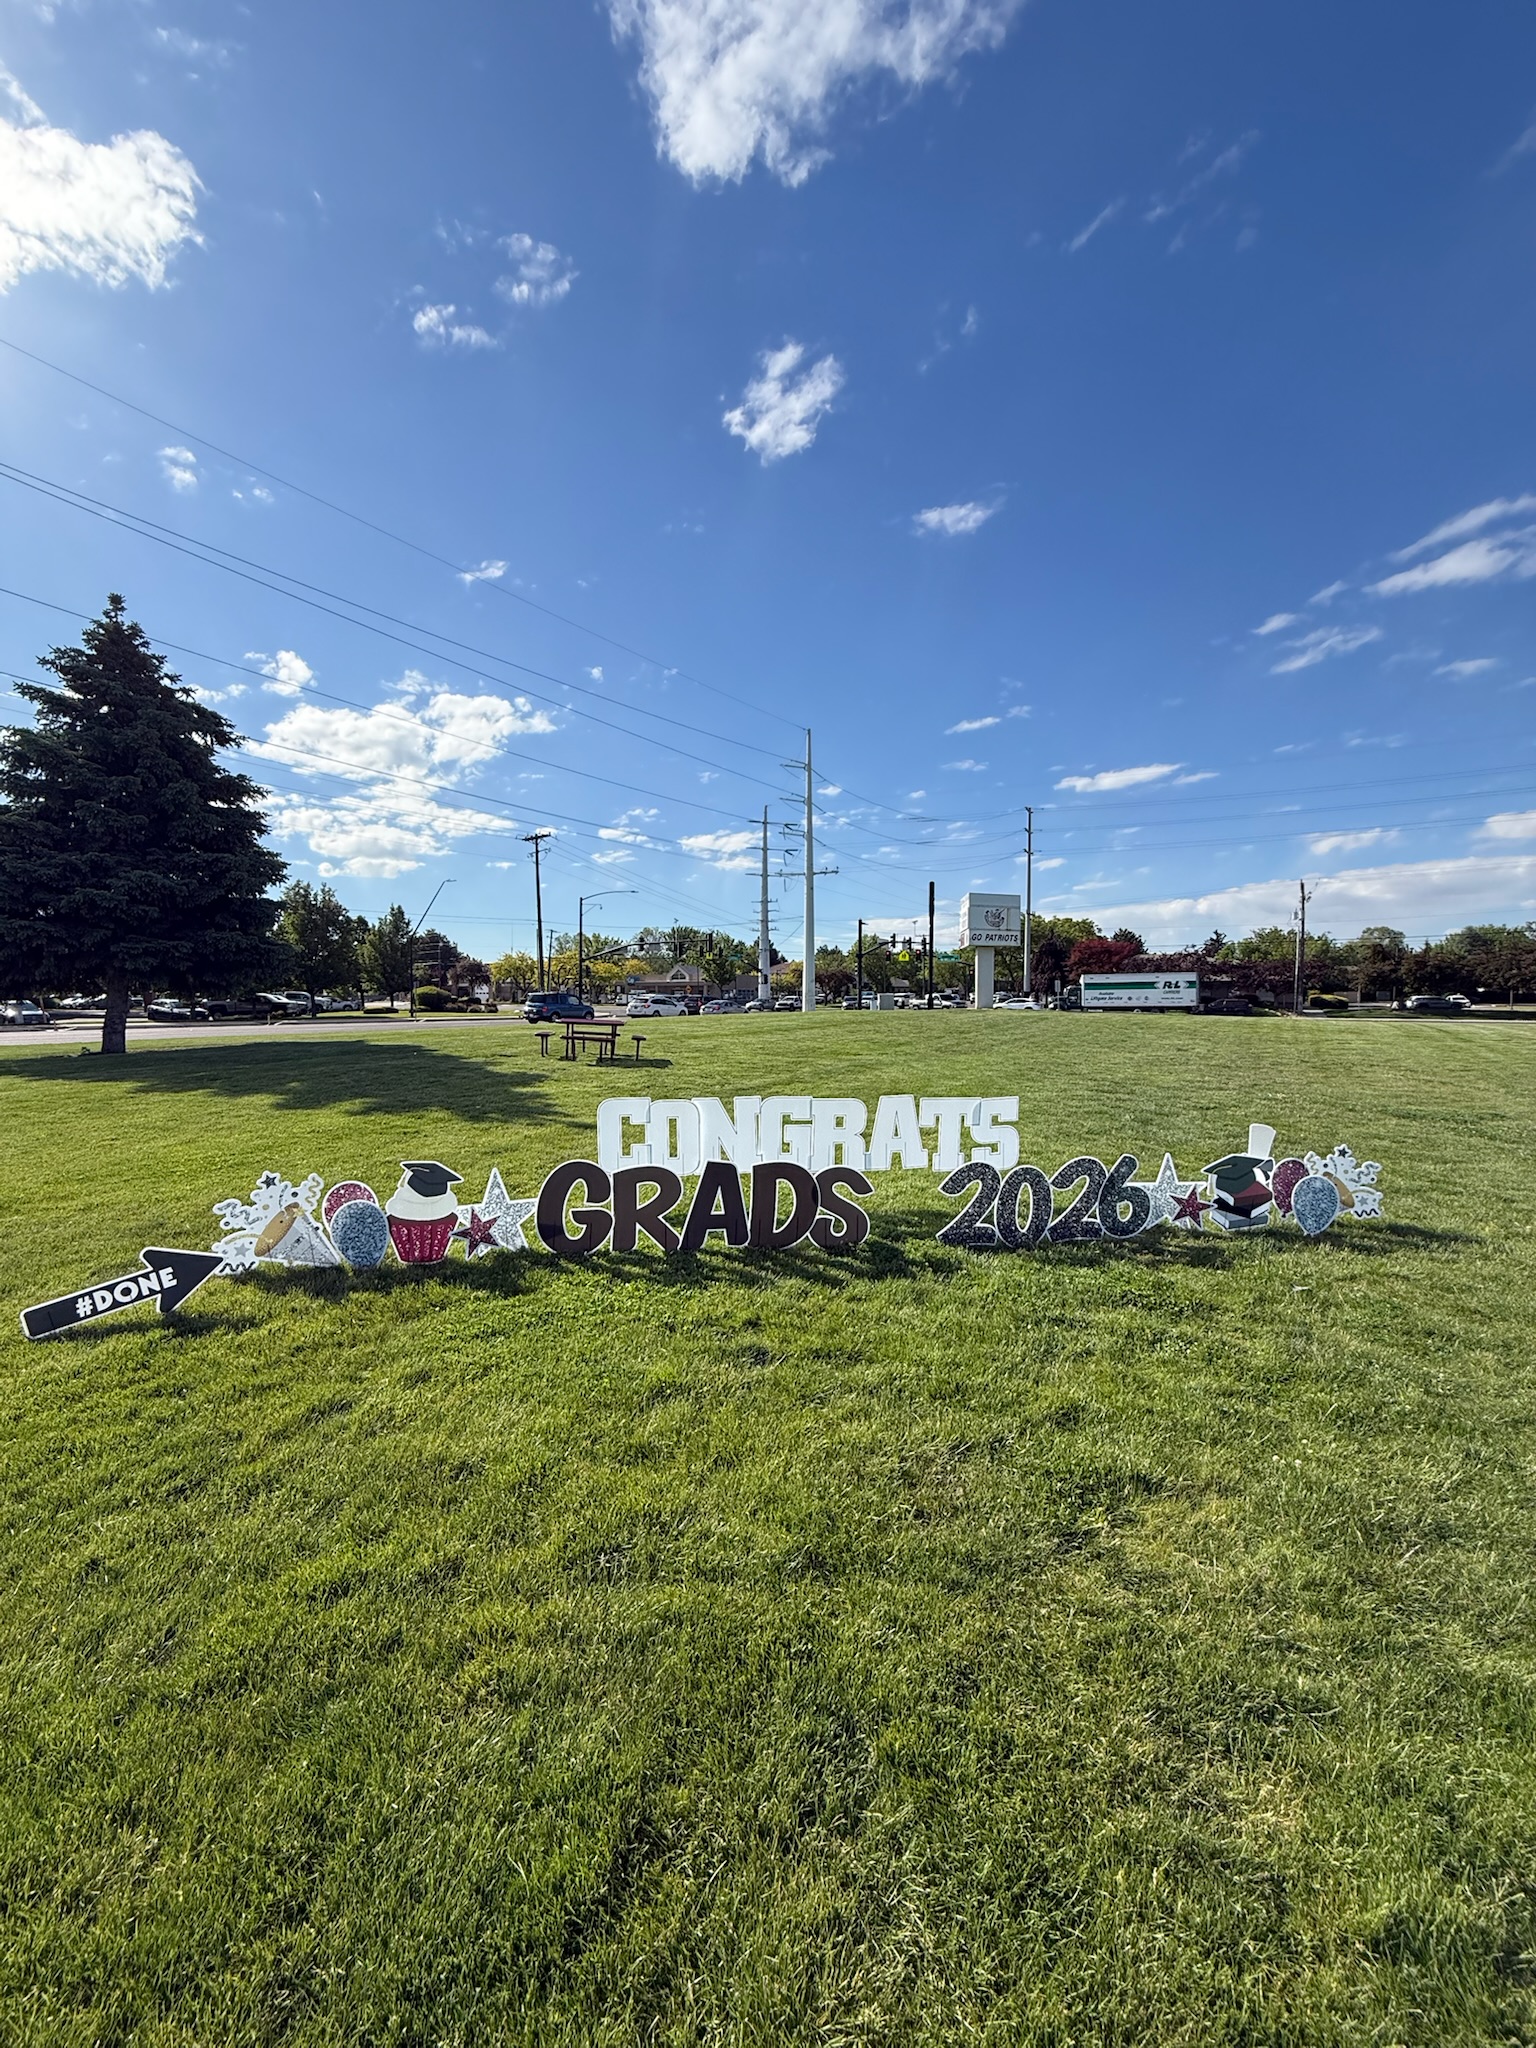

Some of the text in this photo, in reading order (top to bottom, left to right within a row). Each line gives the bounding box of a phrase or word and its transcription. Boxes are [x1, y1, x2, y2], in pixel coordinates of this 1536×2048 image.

[971, 933, 1019, 942] GO PATRIOTS
[597, 1095, 1020, 1176] CONGRATS
[536, 1153, 1152, 1255] GRADS 2026
[76, 1266, 178, 1318] #DONE
